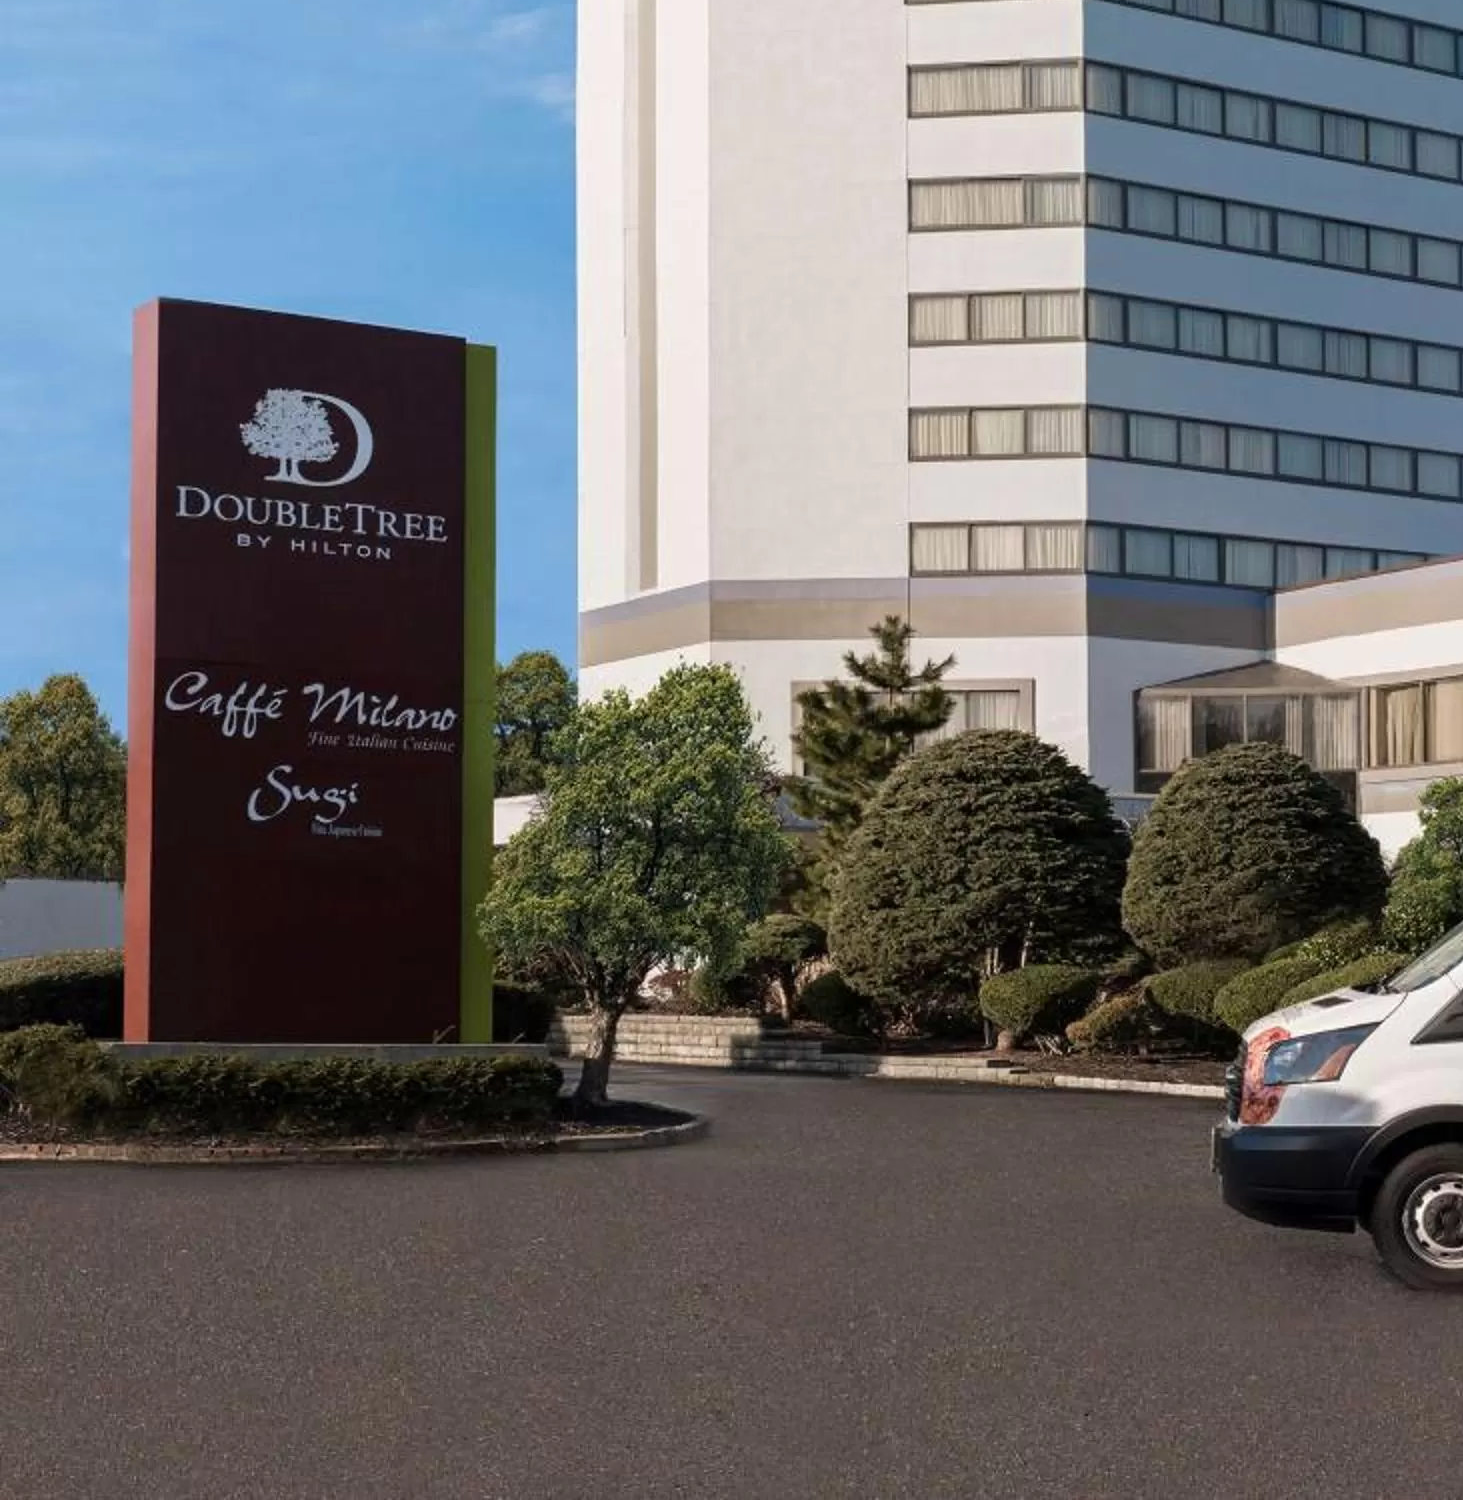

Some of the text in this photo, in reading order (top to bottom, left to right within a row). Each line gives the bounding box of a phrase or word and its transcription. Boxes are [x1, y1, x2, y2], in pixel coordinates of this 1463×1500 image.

[175, 485, 448, 543] DOUBLETREE
[237, 533, 392, 560] BY HILTON
[164, 671, 458, 740] Caffé Milano
[308, 731, 455, 753] Fine Italian Cuisine
[247, 765, 359, 823] Sugi
